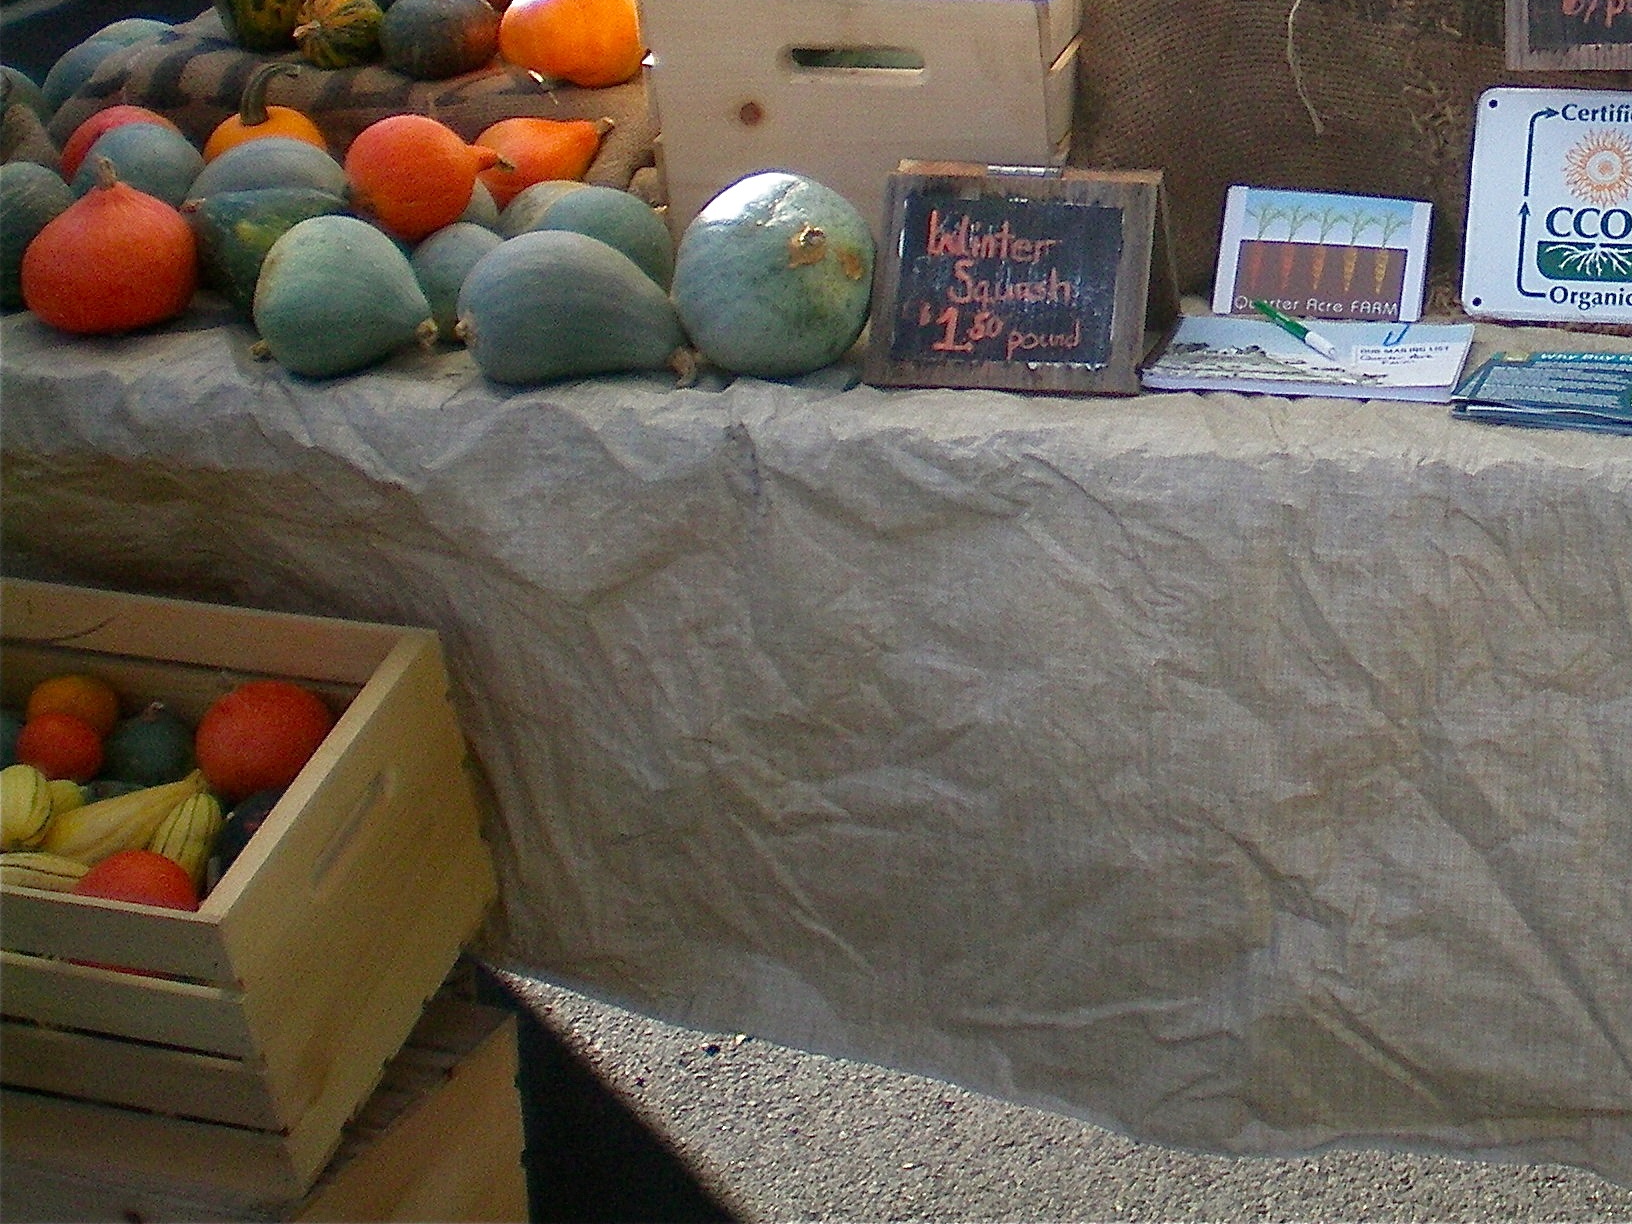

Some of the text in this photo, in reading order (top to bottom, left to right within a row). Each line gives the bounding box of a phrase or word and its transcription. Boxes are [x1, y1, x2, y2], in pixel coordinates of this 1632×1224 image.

[926, 209, 1062, 263] Winter
[946, 258, 1074, 308] Squash
[1305, 297, 1344, 313] Acre
[1350, 300, 1399, 315] FARM
[1006, 320, 1083, 361] pound
